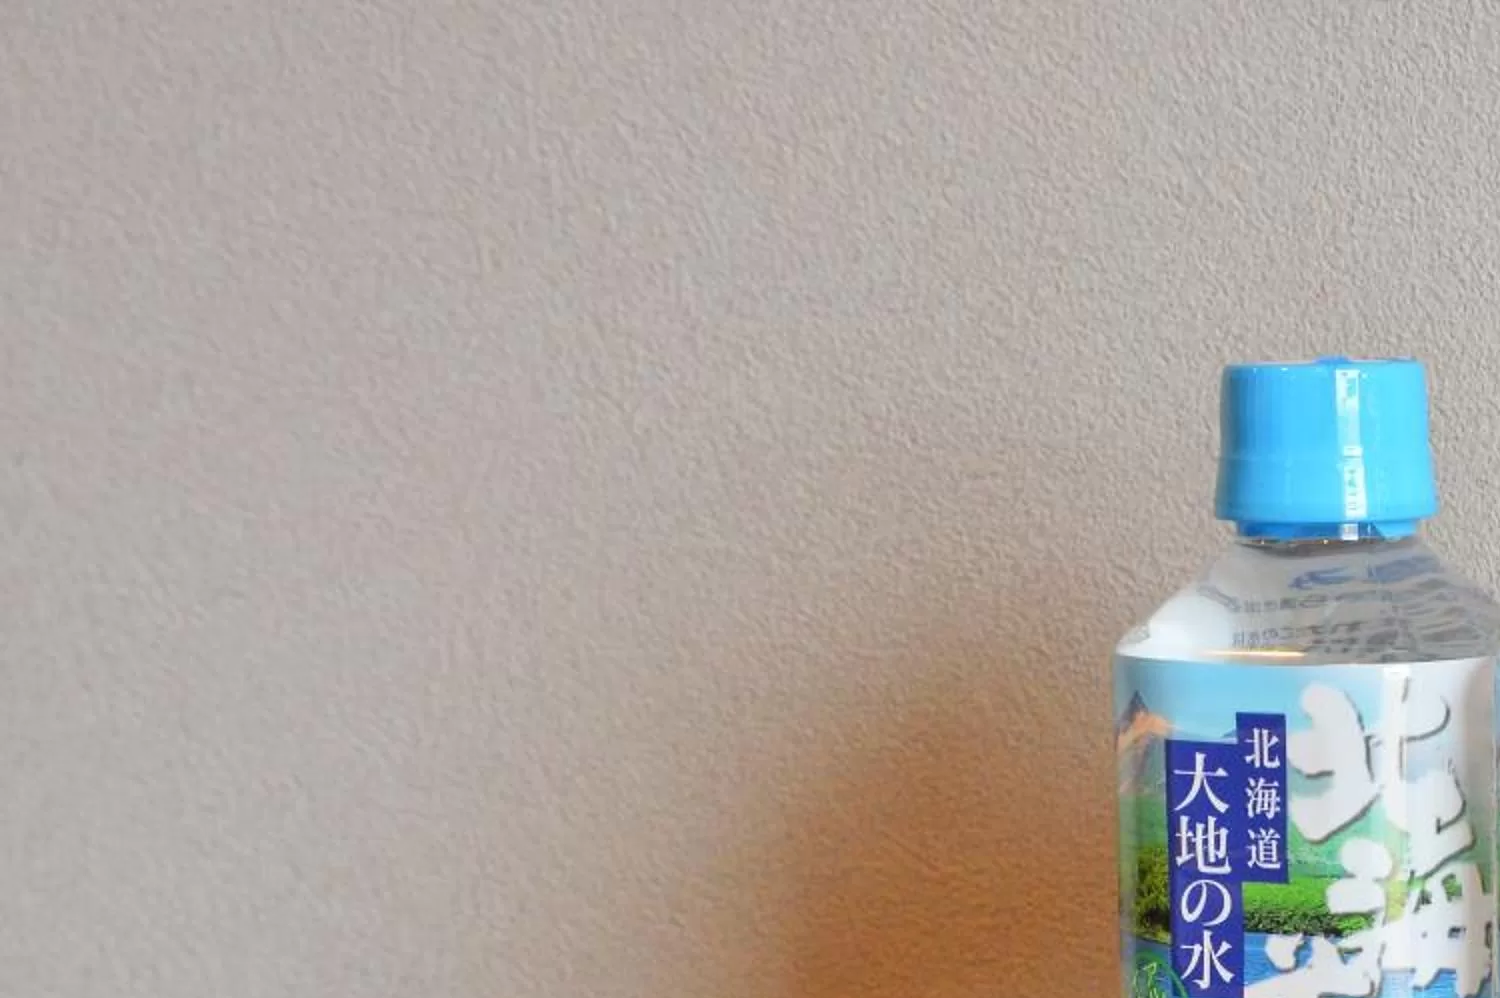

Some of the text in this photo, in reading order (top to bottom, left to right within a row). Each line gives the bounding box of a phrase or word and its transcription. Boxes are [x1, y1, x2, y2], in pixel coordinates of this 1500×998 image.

[1173, 751, 1234, 990] 大地の水
[1245, 727, 1281, 871] 北海道
